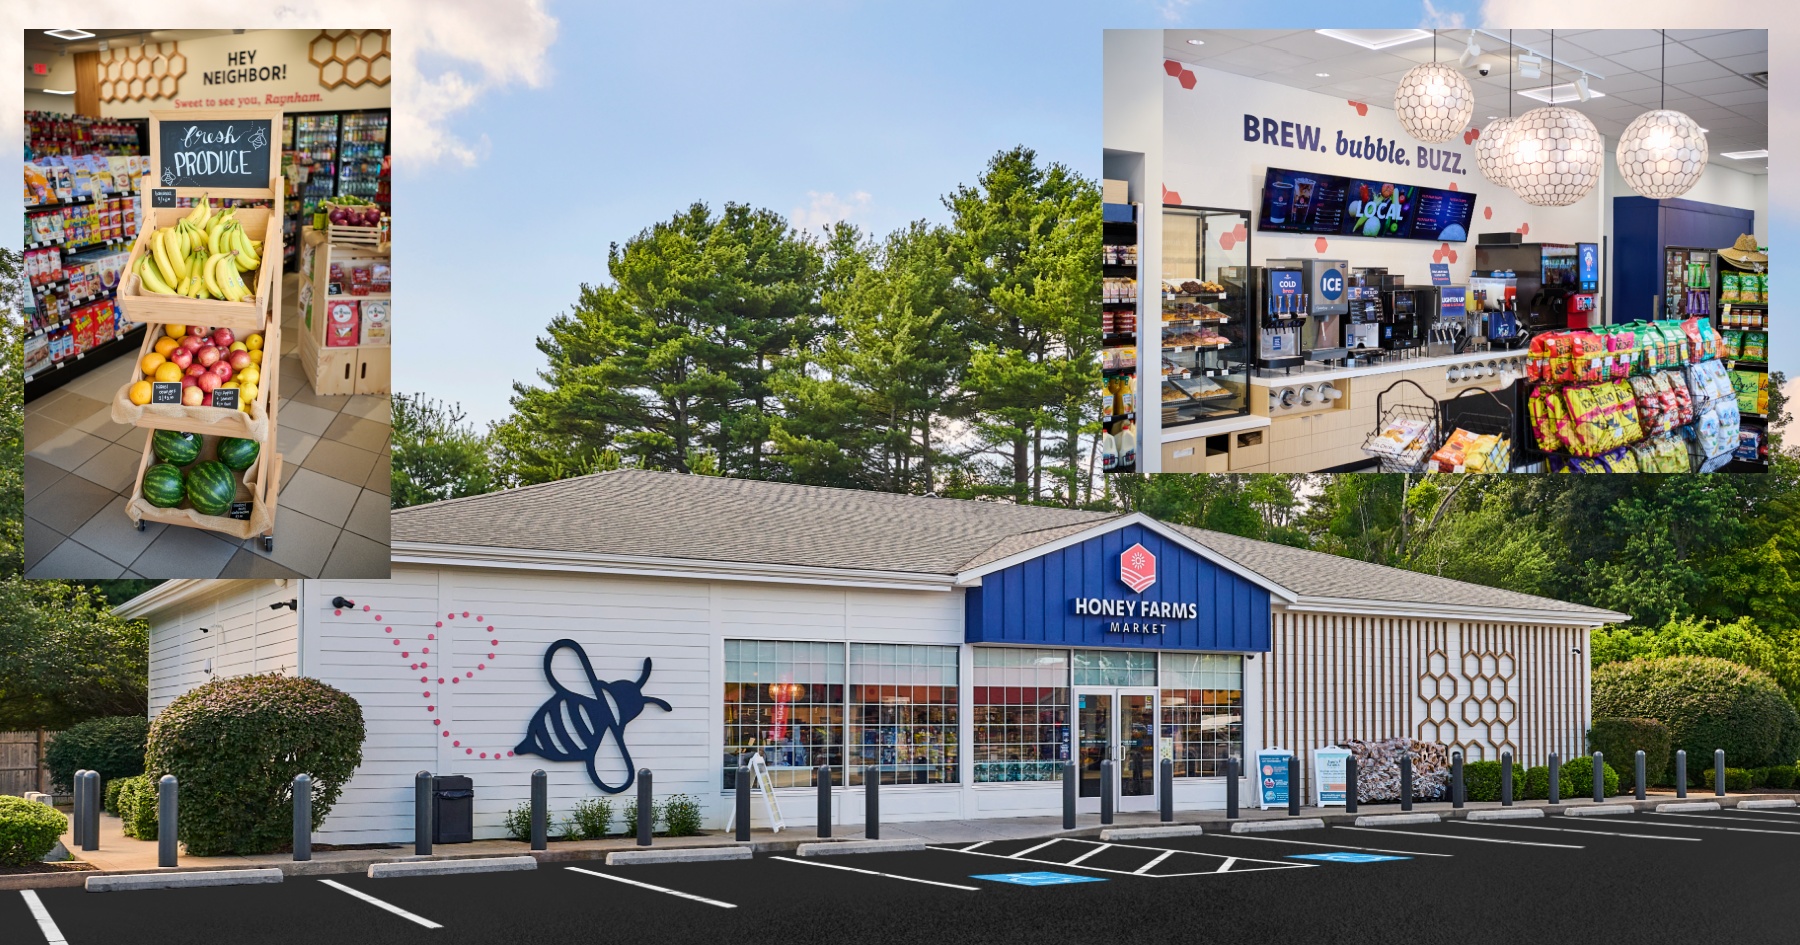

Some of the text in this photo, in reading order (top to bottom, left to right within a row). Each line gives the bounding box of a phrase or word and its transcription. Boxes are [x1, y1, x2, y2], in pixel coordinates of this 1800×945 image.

[228, 50, 257, 66] HEY
[203, 64, 287, 85] NEIGHBOR!
[174, 92, 323, 109] Sweet to see you, Raynham.
[180, 125, 240, 148] fresh
[1243, 113, 1467, 175] BREW. bubble. BUZZ.
[174, 150, 252, 177] PRODUCE
[1355, 199, 1403, 221] LOCAL
[1322, 277, 1342, 292] ICE
[1075, 597, 1197, 619] HONEY FARMS
[1110, 622, 1167, 635] MARKET
